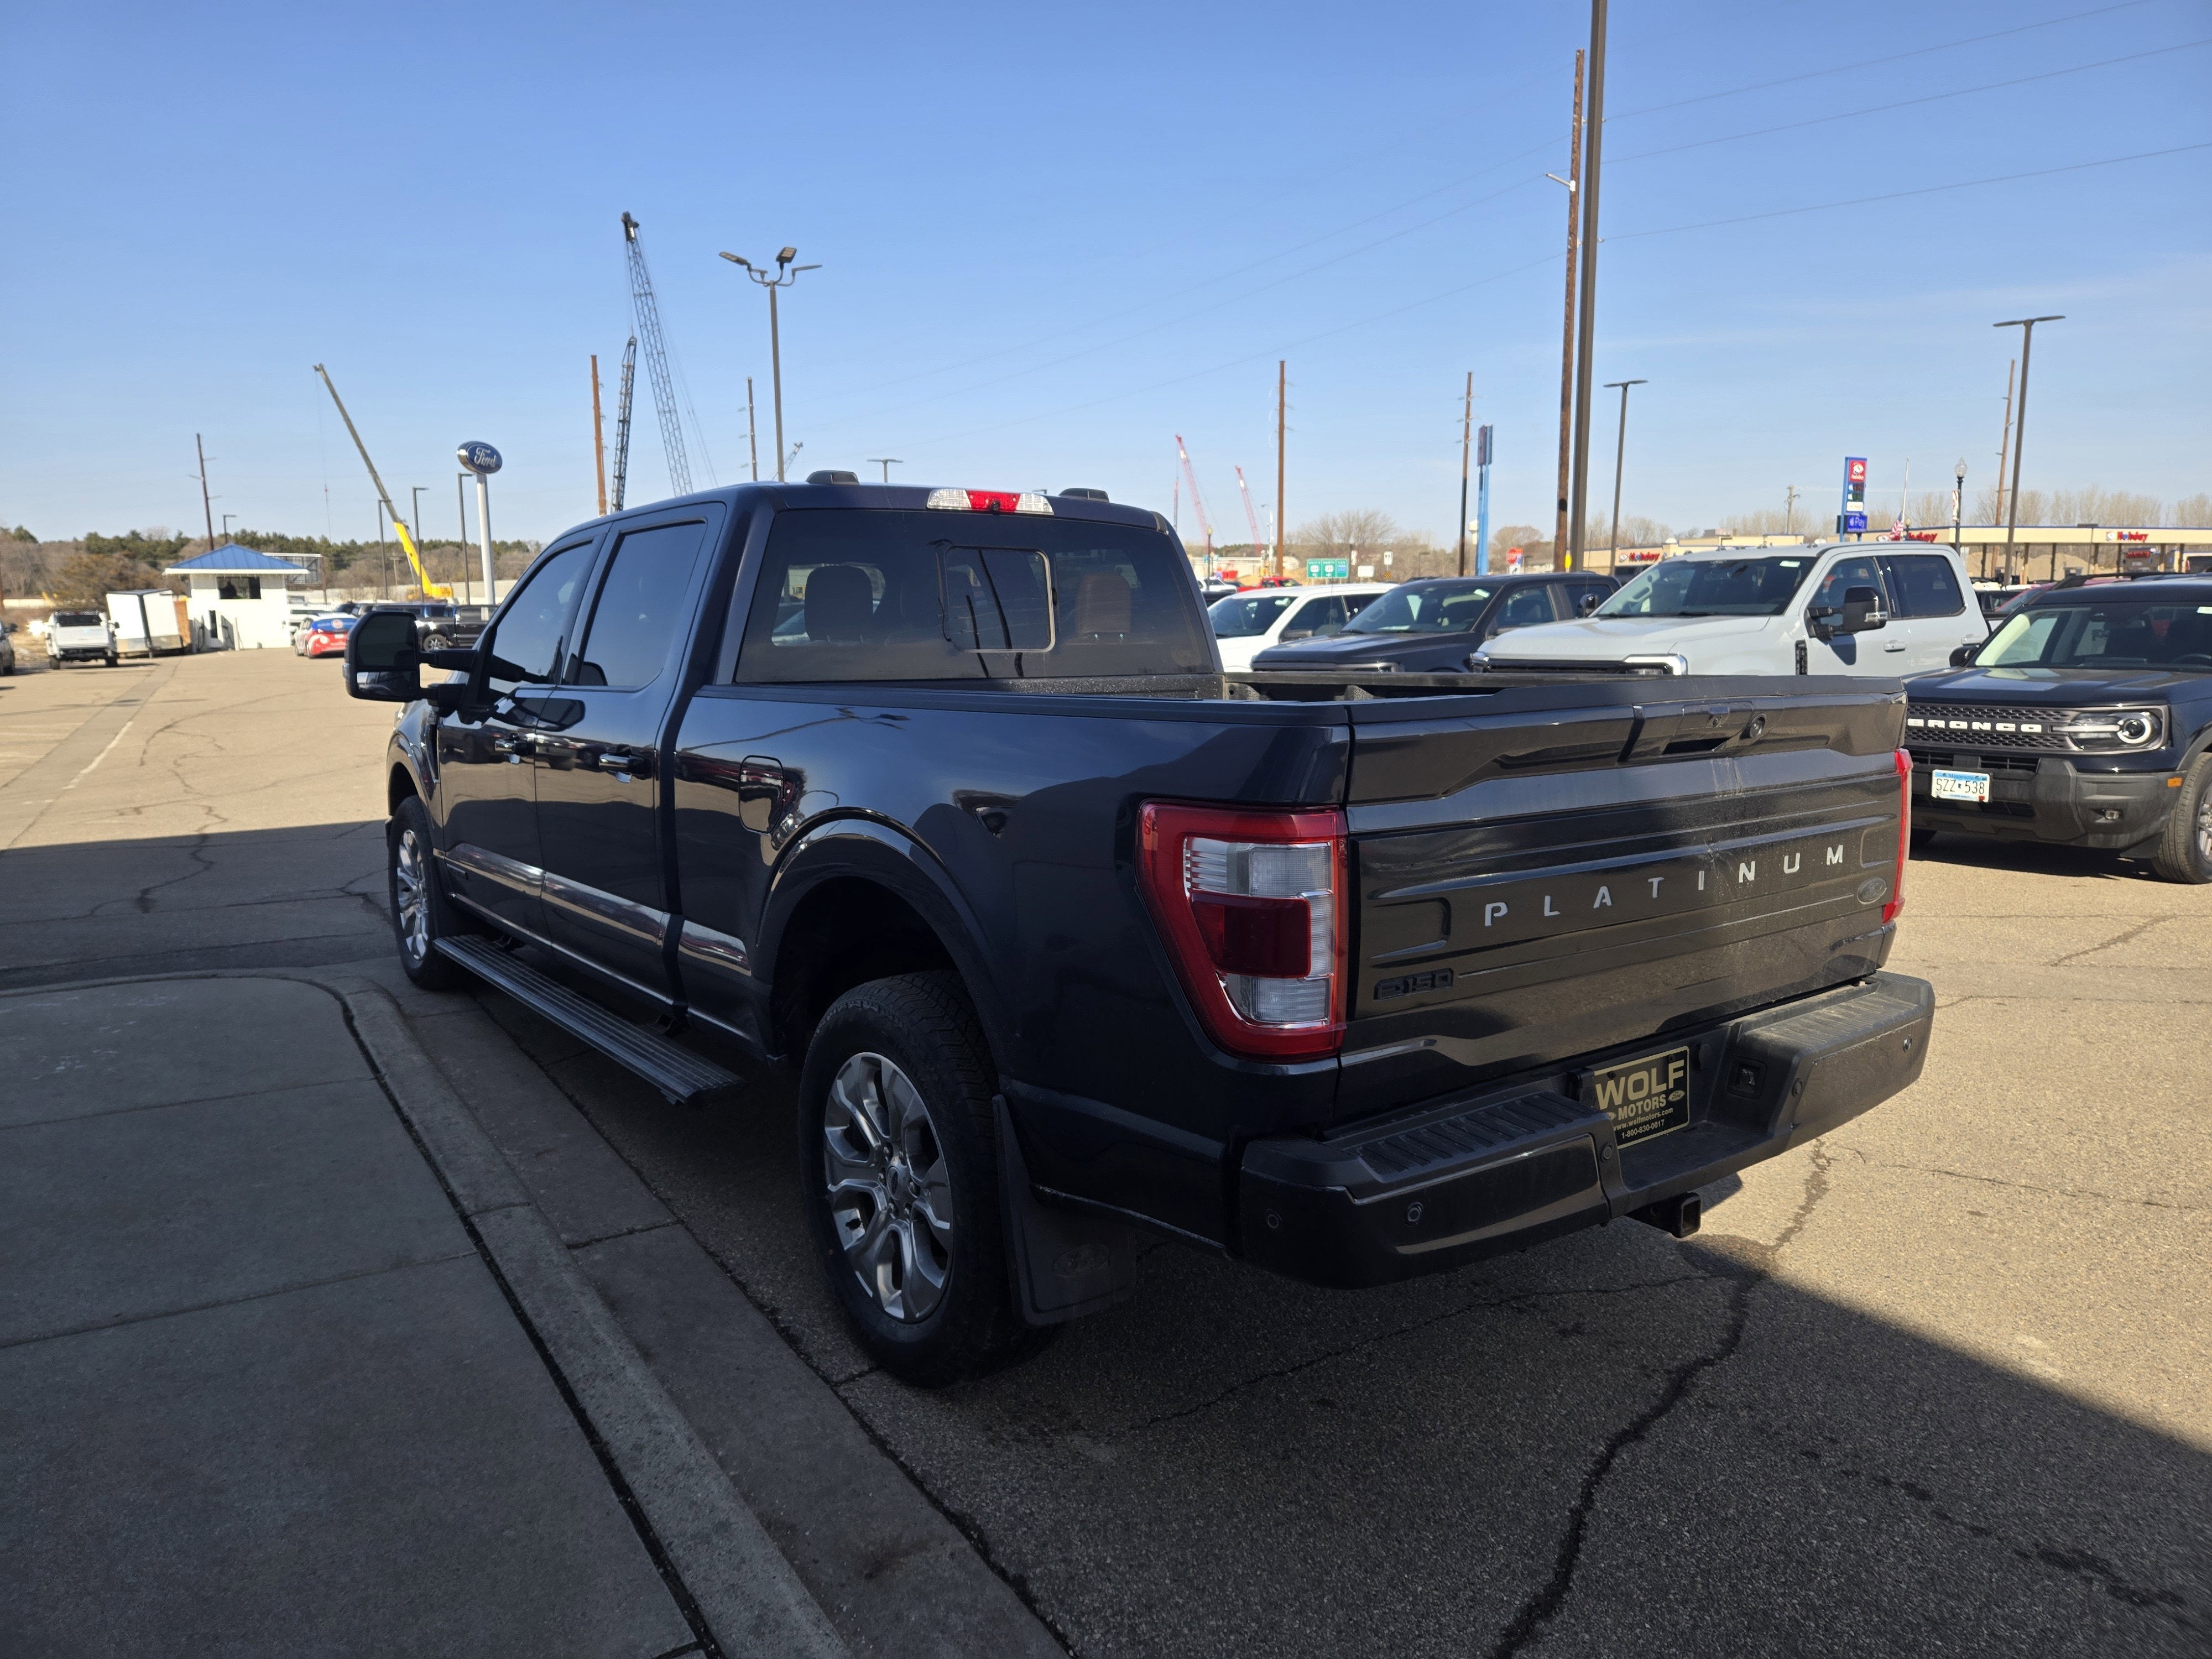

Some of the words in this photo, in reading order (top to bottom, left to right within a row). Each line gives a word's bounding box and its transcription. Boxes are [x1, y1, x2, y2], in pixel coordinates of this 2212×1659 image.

[474, 446, 496, 468] Ford
[1629, 552, 1660, 562] Holiday
[1907, 718, 2042, 733] BRONCO
[1937, 778, 1956, 792] SZZ
[1965, 780, 1985, 794] 538
[1484, 844, 1844, 927] PLATINUM
[1595, 1059, 1684, 1110] WOLF
[1618, 1093, 1667, 1121] MOTORS
[1621, 1119, 1665, 1139] 1-800-830-0017
